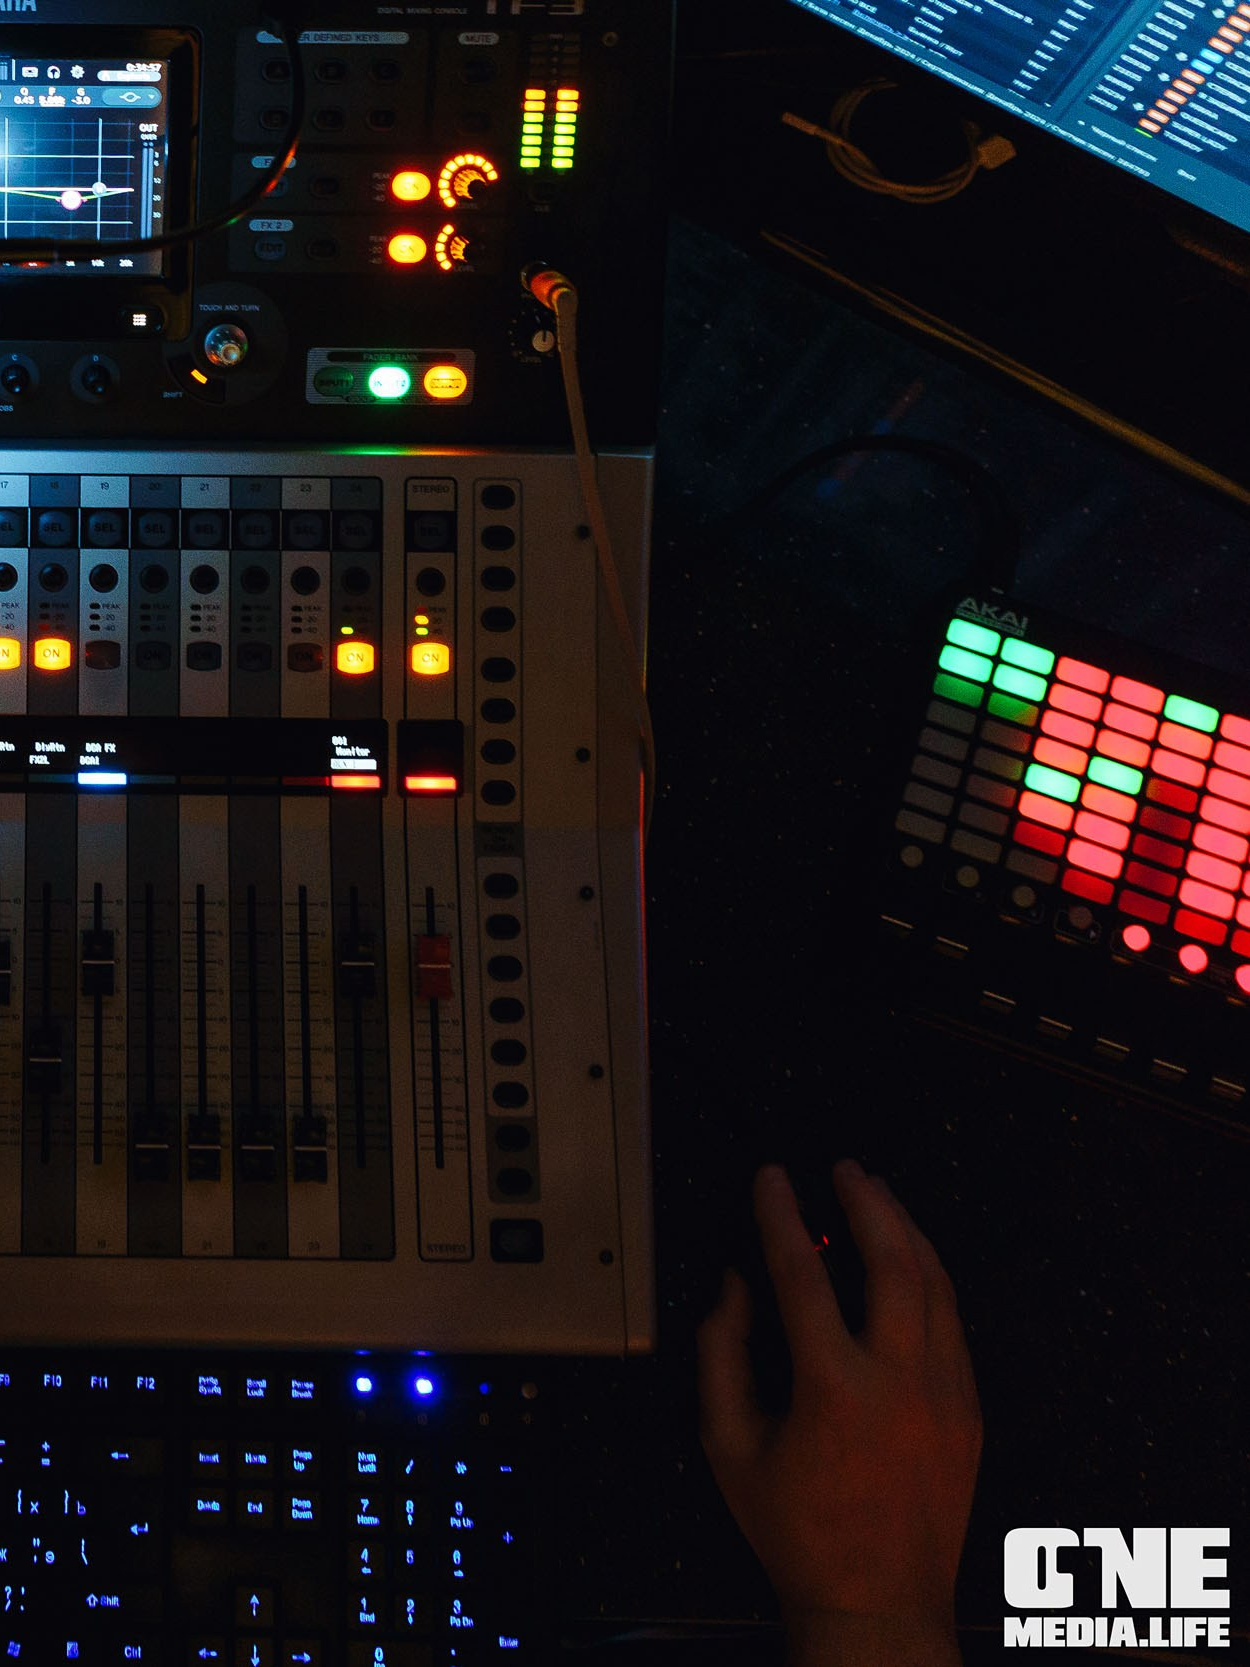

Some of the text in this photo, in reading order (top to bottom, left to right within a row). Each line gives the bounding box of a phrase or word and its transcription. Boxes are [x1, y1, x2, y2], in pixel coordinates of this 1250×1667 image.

[356, 34, 380, 42] KEYS
[466, 35, 492, 43] MUTE
[199, 304, 260, 312] TOUCH AND TURN
[0, 481, 9, 489] 17
[100, 482, 110, 490] 19
[200, 483, 210, 491] 21
[412, 485, 450, 494] STEREO
[955, 596, 1029, 629] AKAI
[422, 653, 439, 663] ON
[44, 1374, 62, 1387] F10
[91, 1376, 108, 1388] F11
[137, 1376, 155, 1390] F12
